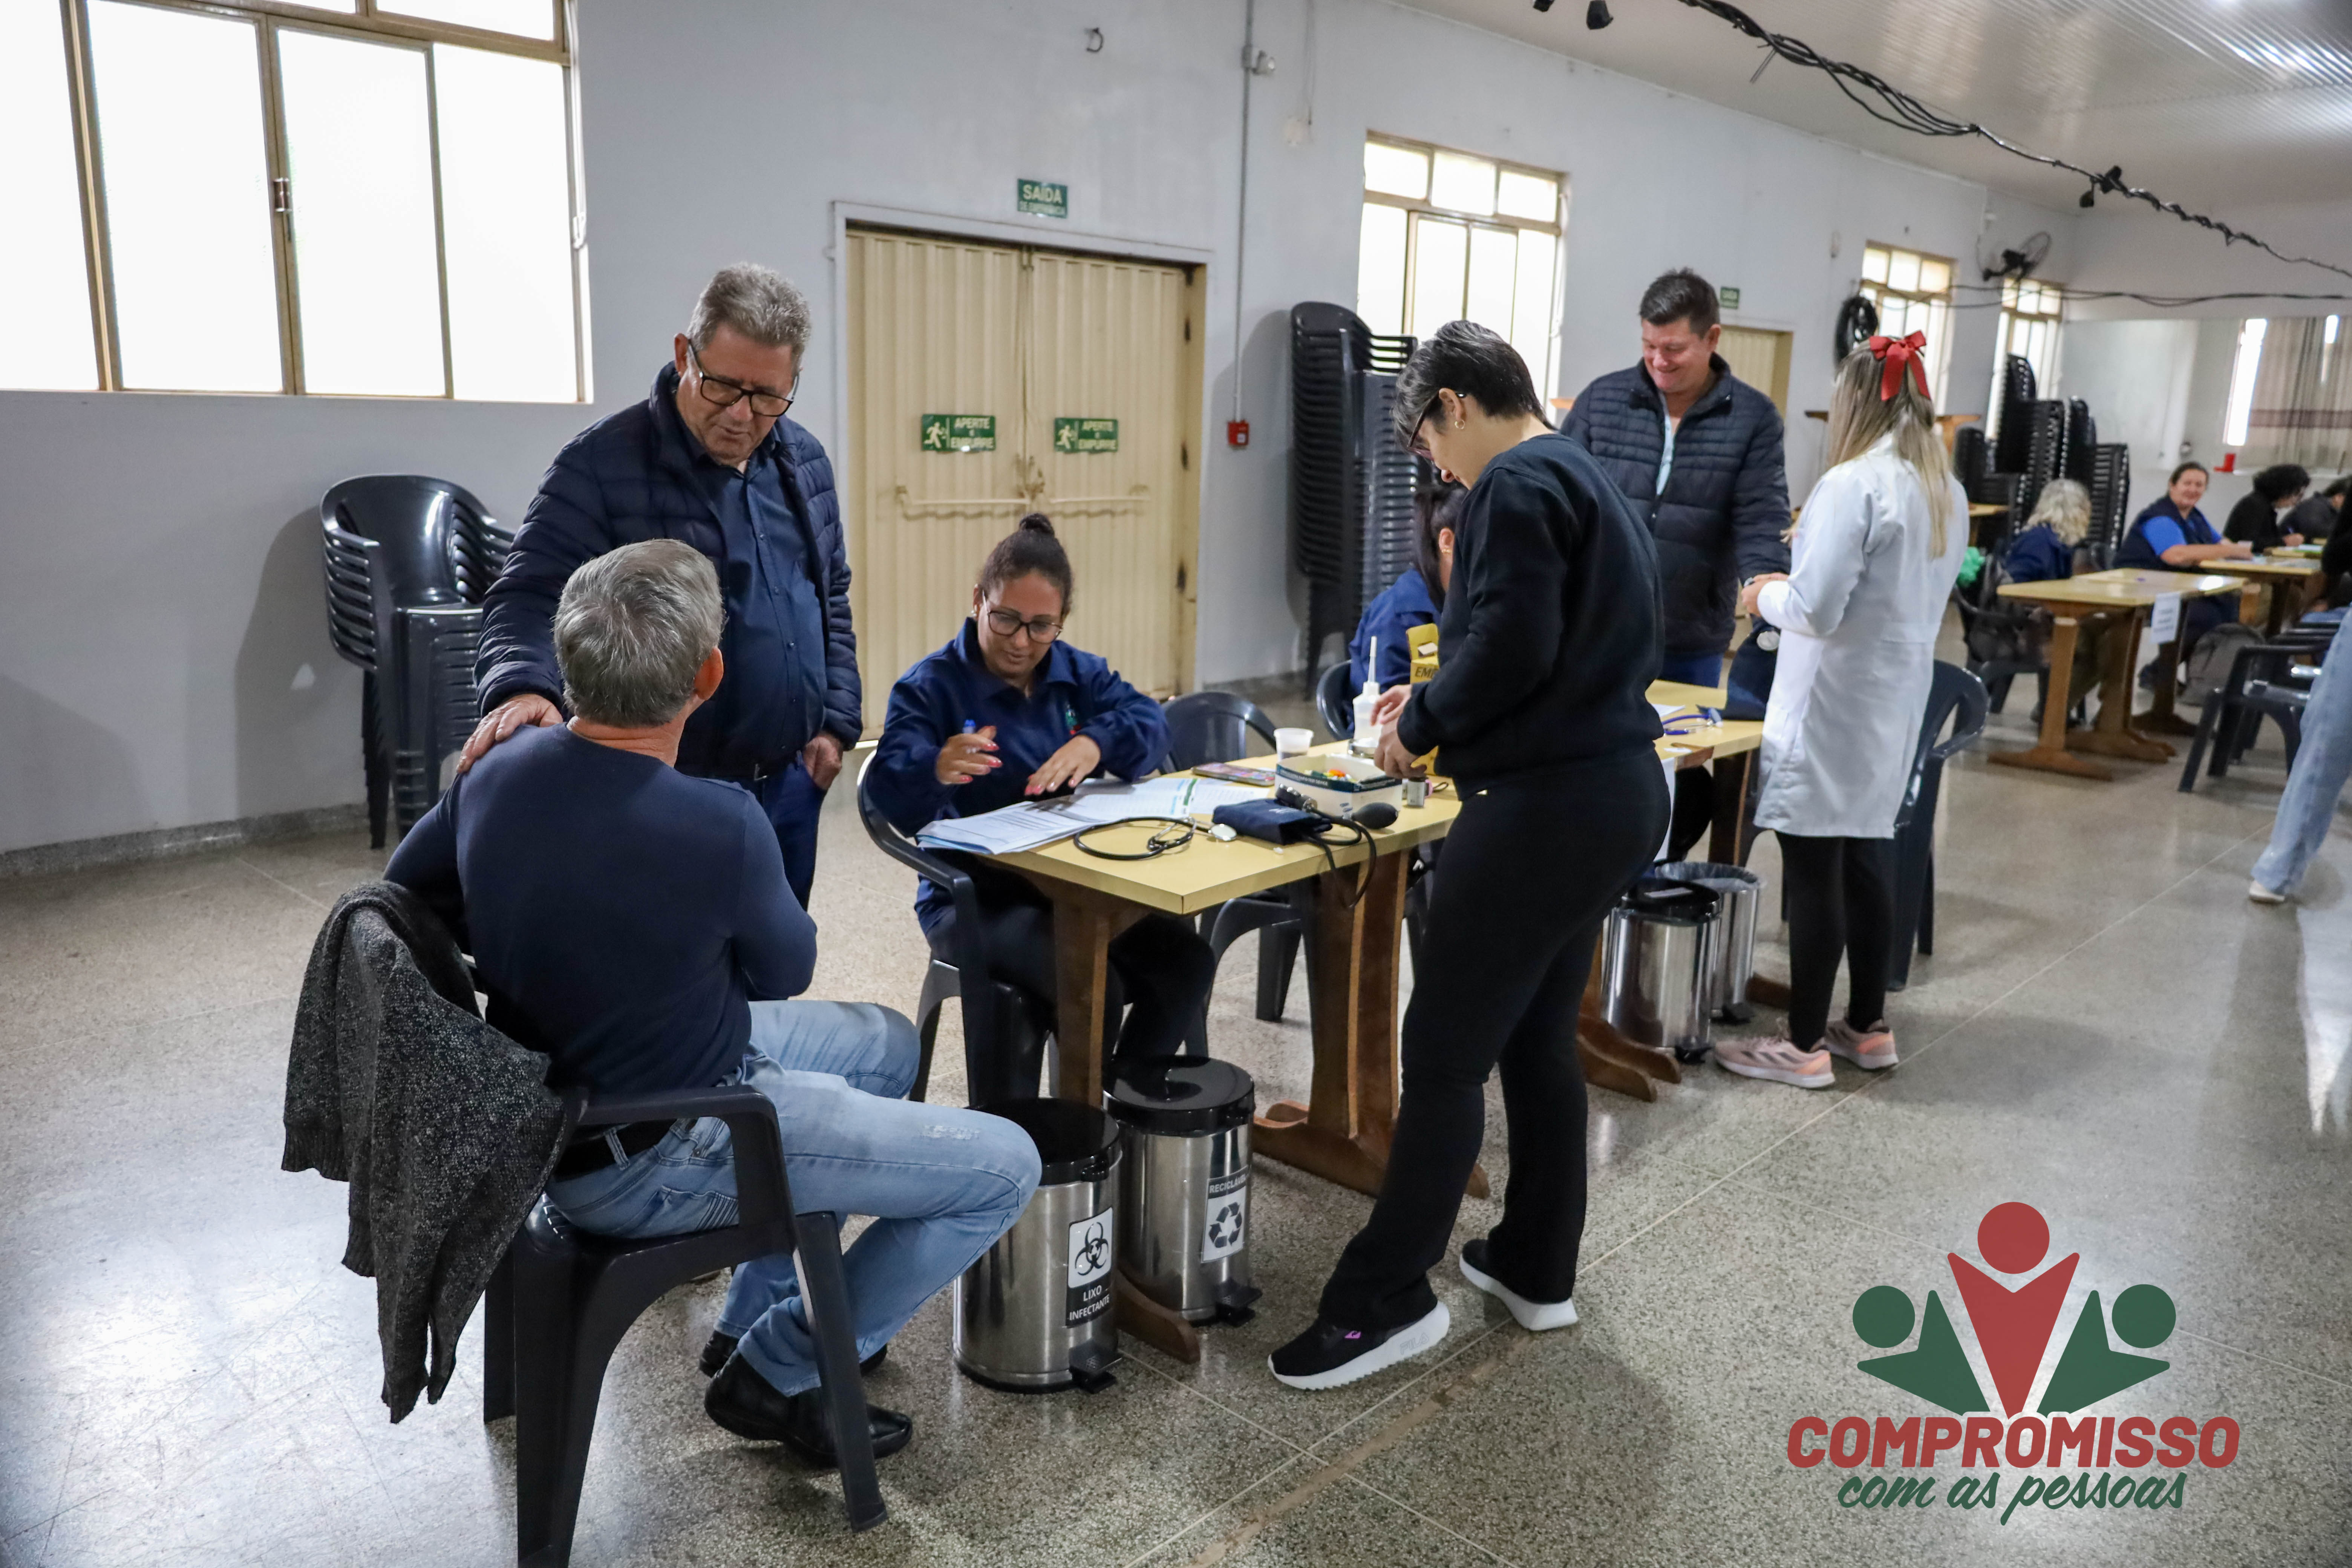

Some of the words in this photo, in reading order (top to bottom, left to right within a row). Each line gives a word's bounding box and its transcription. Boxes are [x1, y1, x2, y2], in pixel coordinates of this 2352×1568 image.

[1083, 1285, 1102, 1302] LIXO
[1069, 1293, 1110, 1321] INFECTANTE
[1400, 1332, 1429, 1355] FILA
